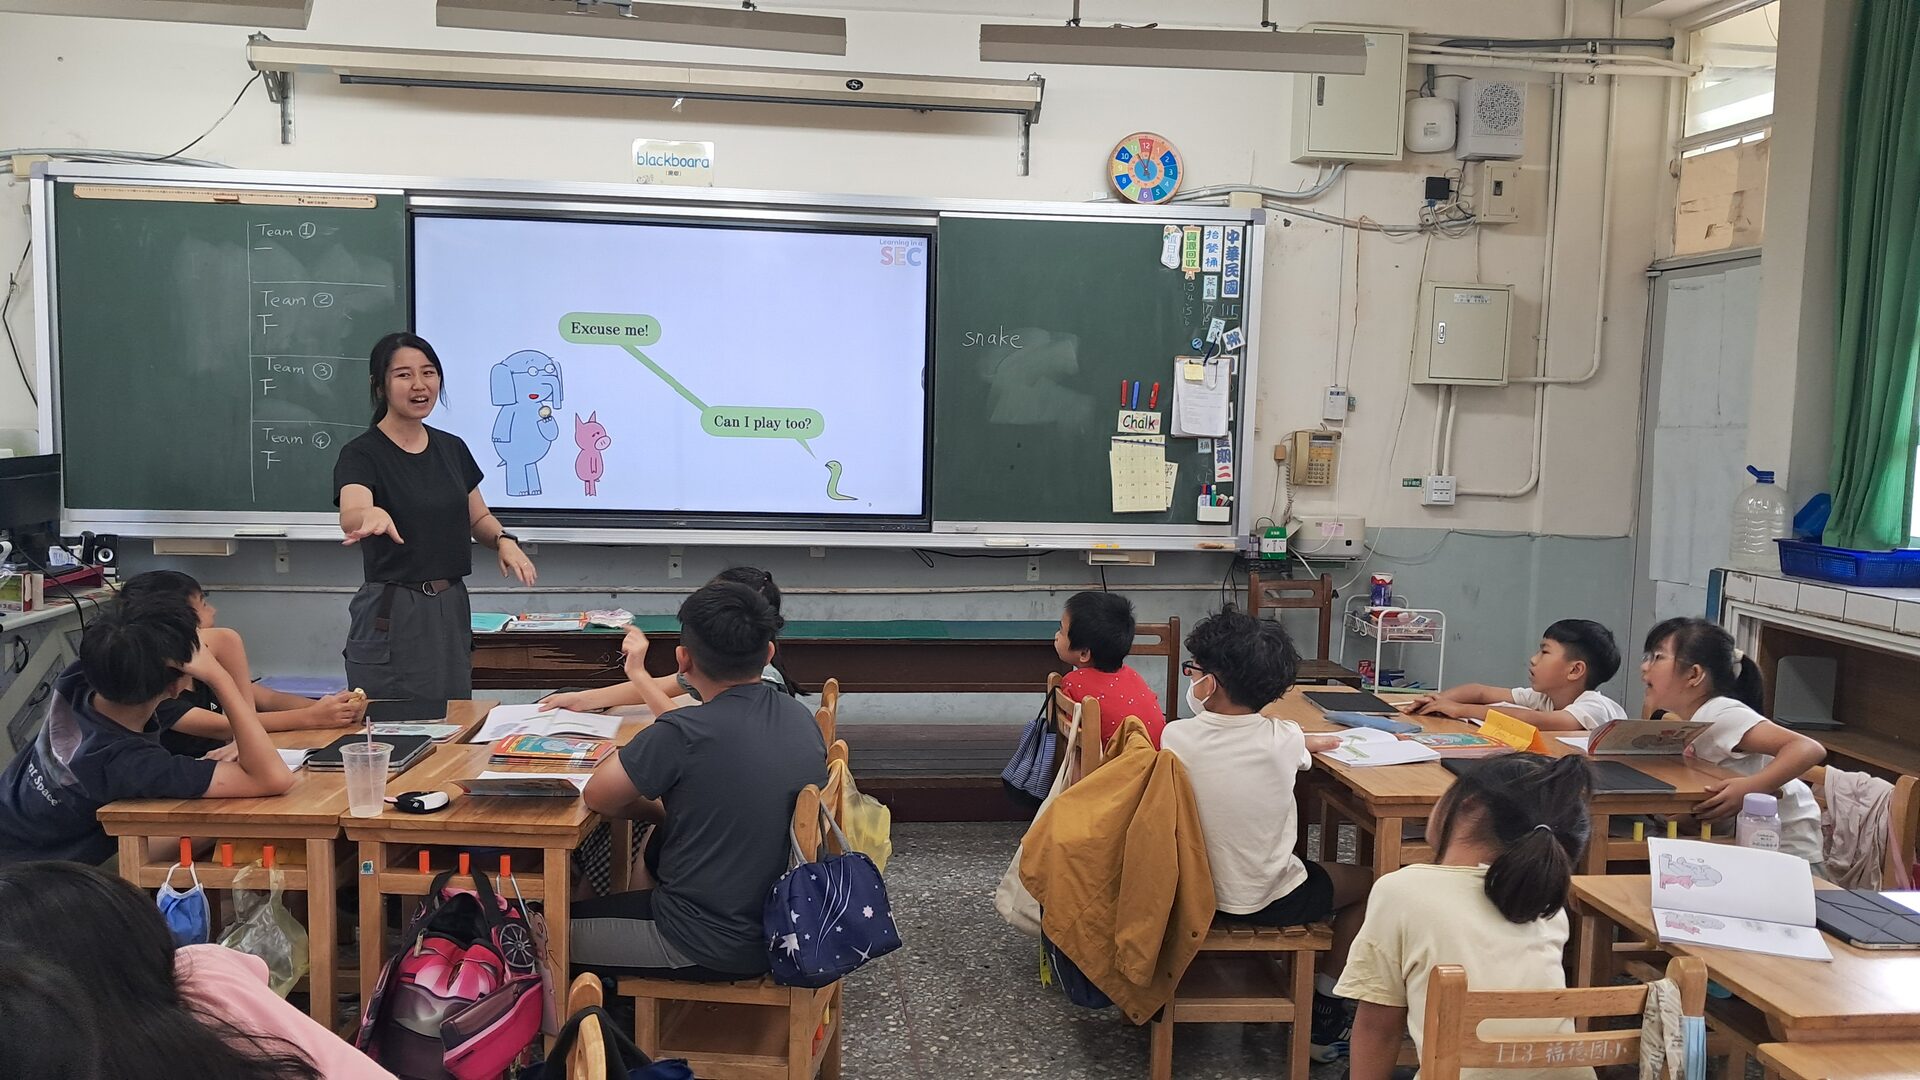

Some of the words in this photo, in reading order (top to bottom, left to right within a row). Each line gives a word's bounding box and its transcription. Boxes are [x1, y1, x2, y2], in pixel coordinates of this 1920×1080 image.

[1168, 168, 1174, 176] 3
[1142, 191, 1148, 199] 6
[1155, 188, 1161, 196] 5
[255, 223, 293, 237] Team
[880, 246, 922, 267] SEC
[1223, 229, 1240, 295] 中華民國
[260, 290, 306, 308] Team
[571, 322, 621, 336] Excuse
[624, 324, 649, 337] me!
[962, 325, 1024, 349] snake
[264, 356, 305, 375] Team
[714, 415, 740, 428] Can
[744, 416, 750, 428] I
[753, 416, 782, 432] play
[785, 417, 812, 430] too?
[1122, 415, 1156, 431] Chalk
[262, 427, 304, 445] Team
[33, 775, 59, 807] Space
[1498, 1042, 1534, 1063] 113
